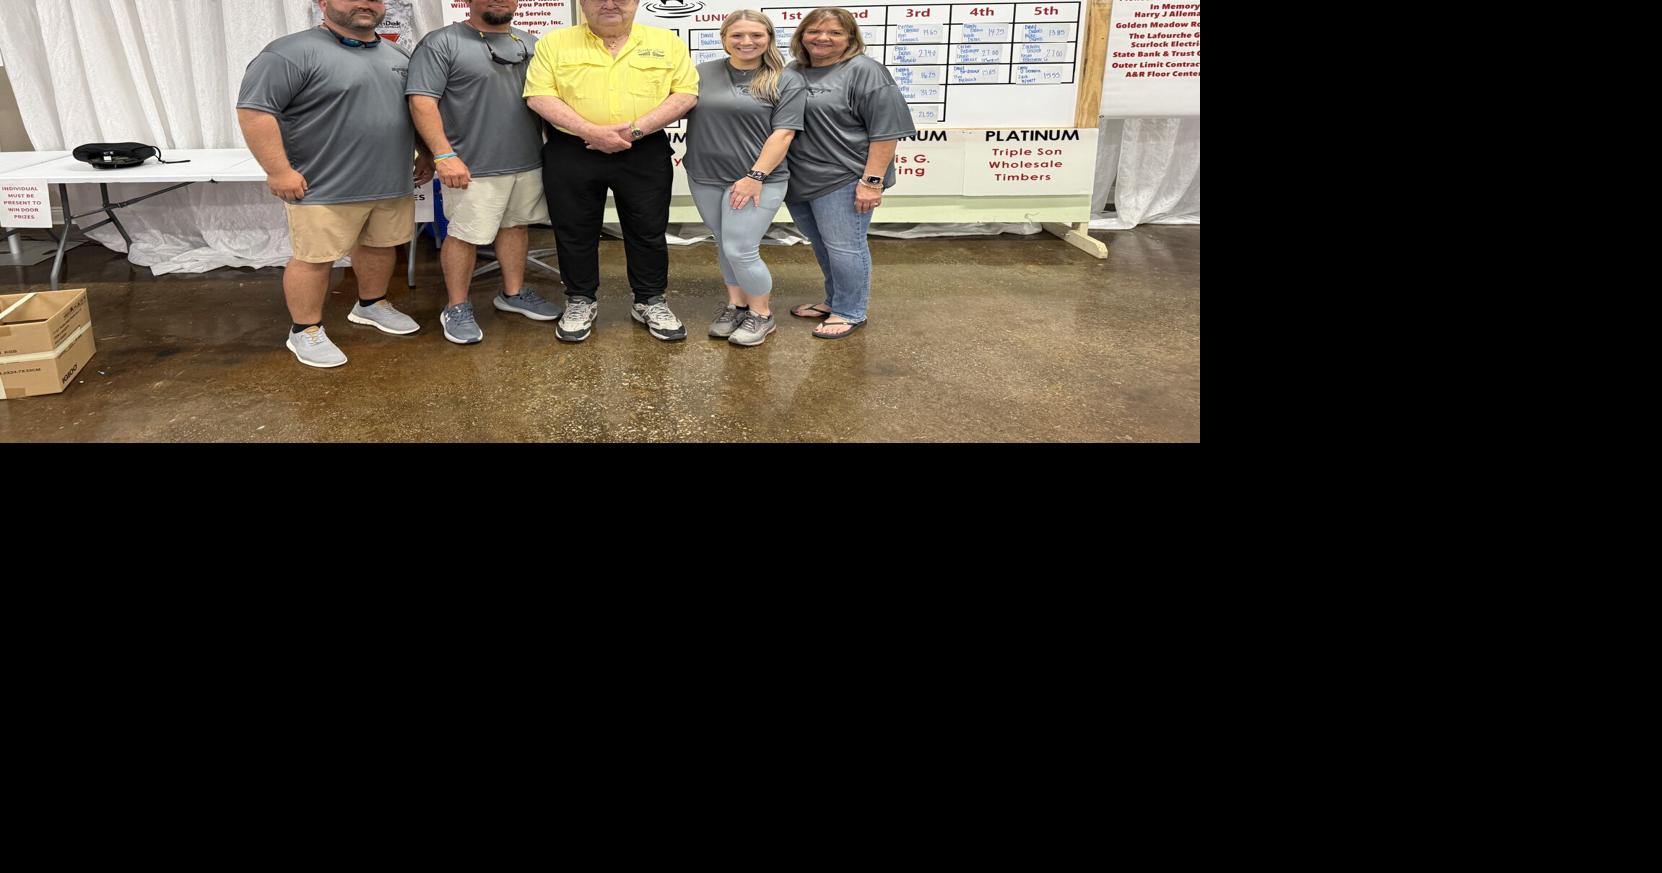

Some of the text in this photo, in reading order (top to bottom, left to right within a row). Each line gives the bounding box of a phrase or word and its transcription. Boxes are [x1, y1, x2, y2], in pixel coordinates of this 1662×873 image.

[781, 11, 803, 21] 1st
[851, 9, 869, 19] nd
[905, 8, 931, 18] 3rd
[969, 7, 995, 17] 4th
[1034, 6, 1059, 16] 5th
[985, 129, 1080, 142] PLATINUM
[992, 148, 1062, 157] Triple Son
[894, 154, 930, 164] is G.
[989, 160, 1063, 169] Wholesale
[895, 166, 926, 177] ing
[994, 173, 1052, 182] Timbers
